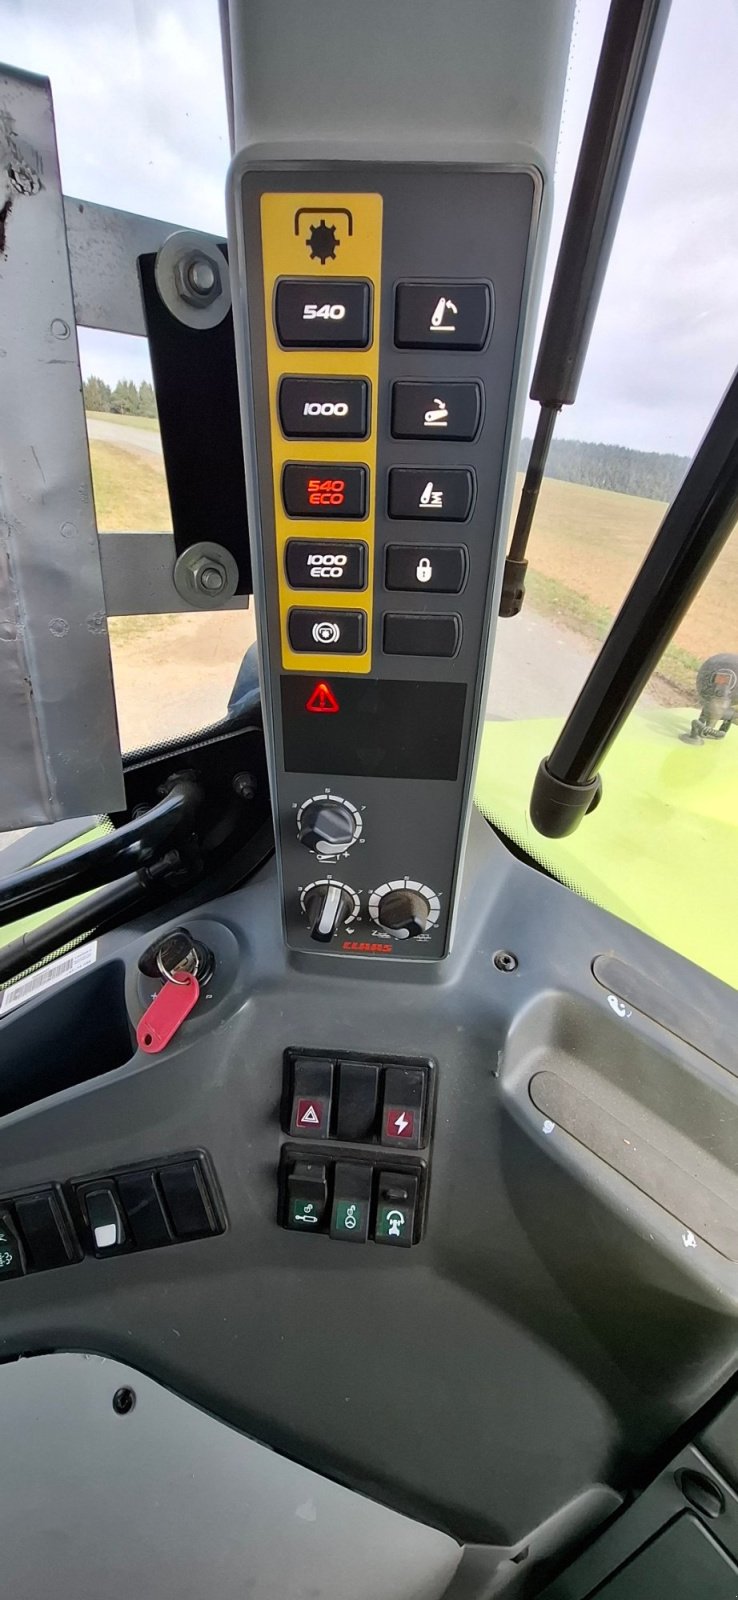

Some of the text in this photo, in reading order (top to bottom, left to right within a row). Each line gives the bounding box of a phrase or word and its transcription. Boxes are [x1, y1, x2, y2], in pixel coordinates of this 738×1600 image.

[302, 304, 346, 320] 540
[303, 402, 349, 417] 1000
[307, 480, 346, 493] 540
[308, 492, 345, 505] ECO
[306, 554, 348, 567] 1000
[309, 566, 344, 578] ECO
[343, 941, 393, 952] CLAAS
